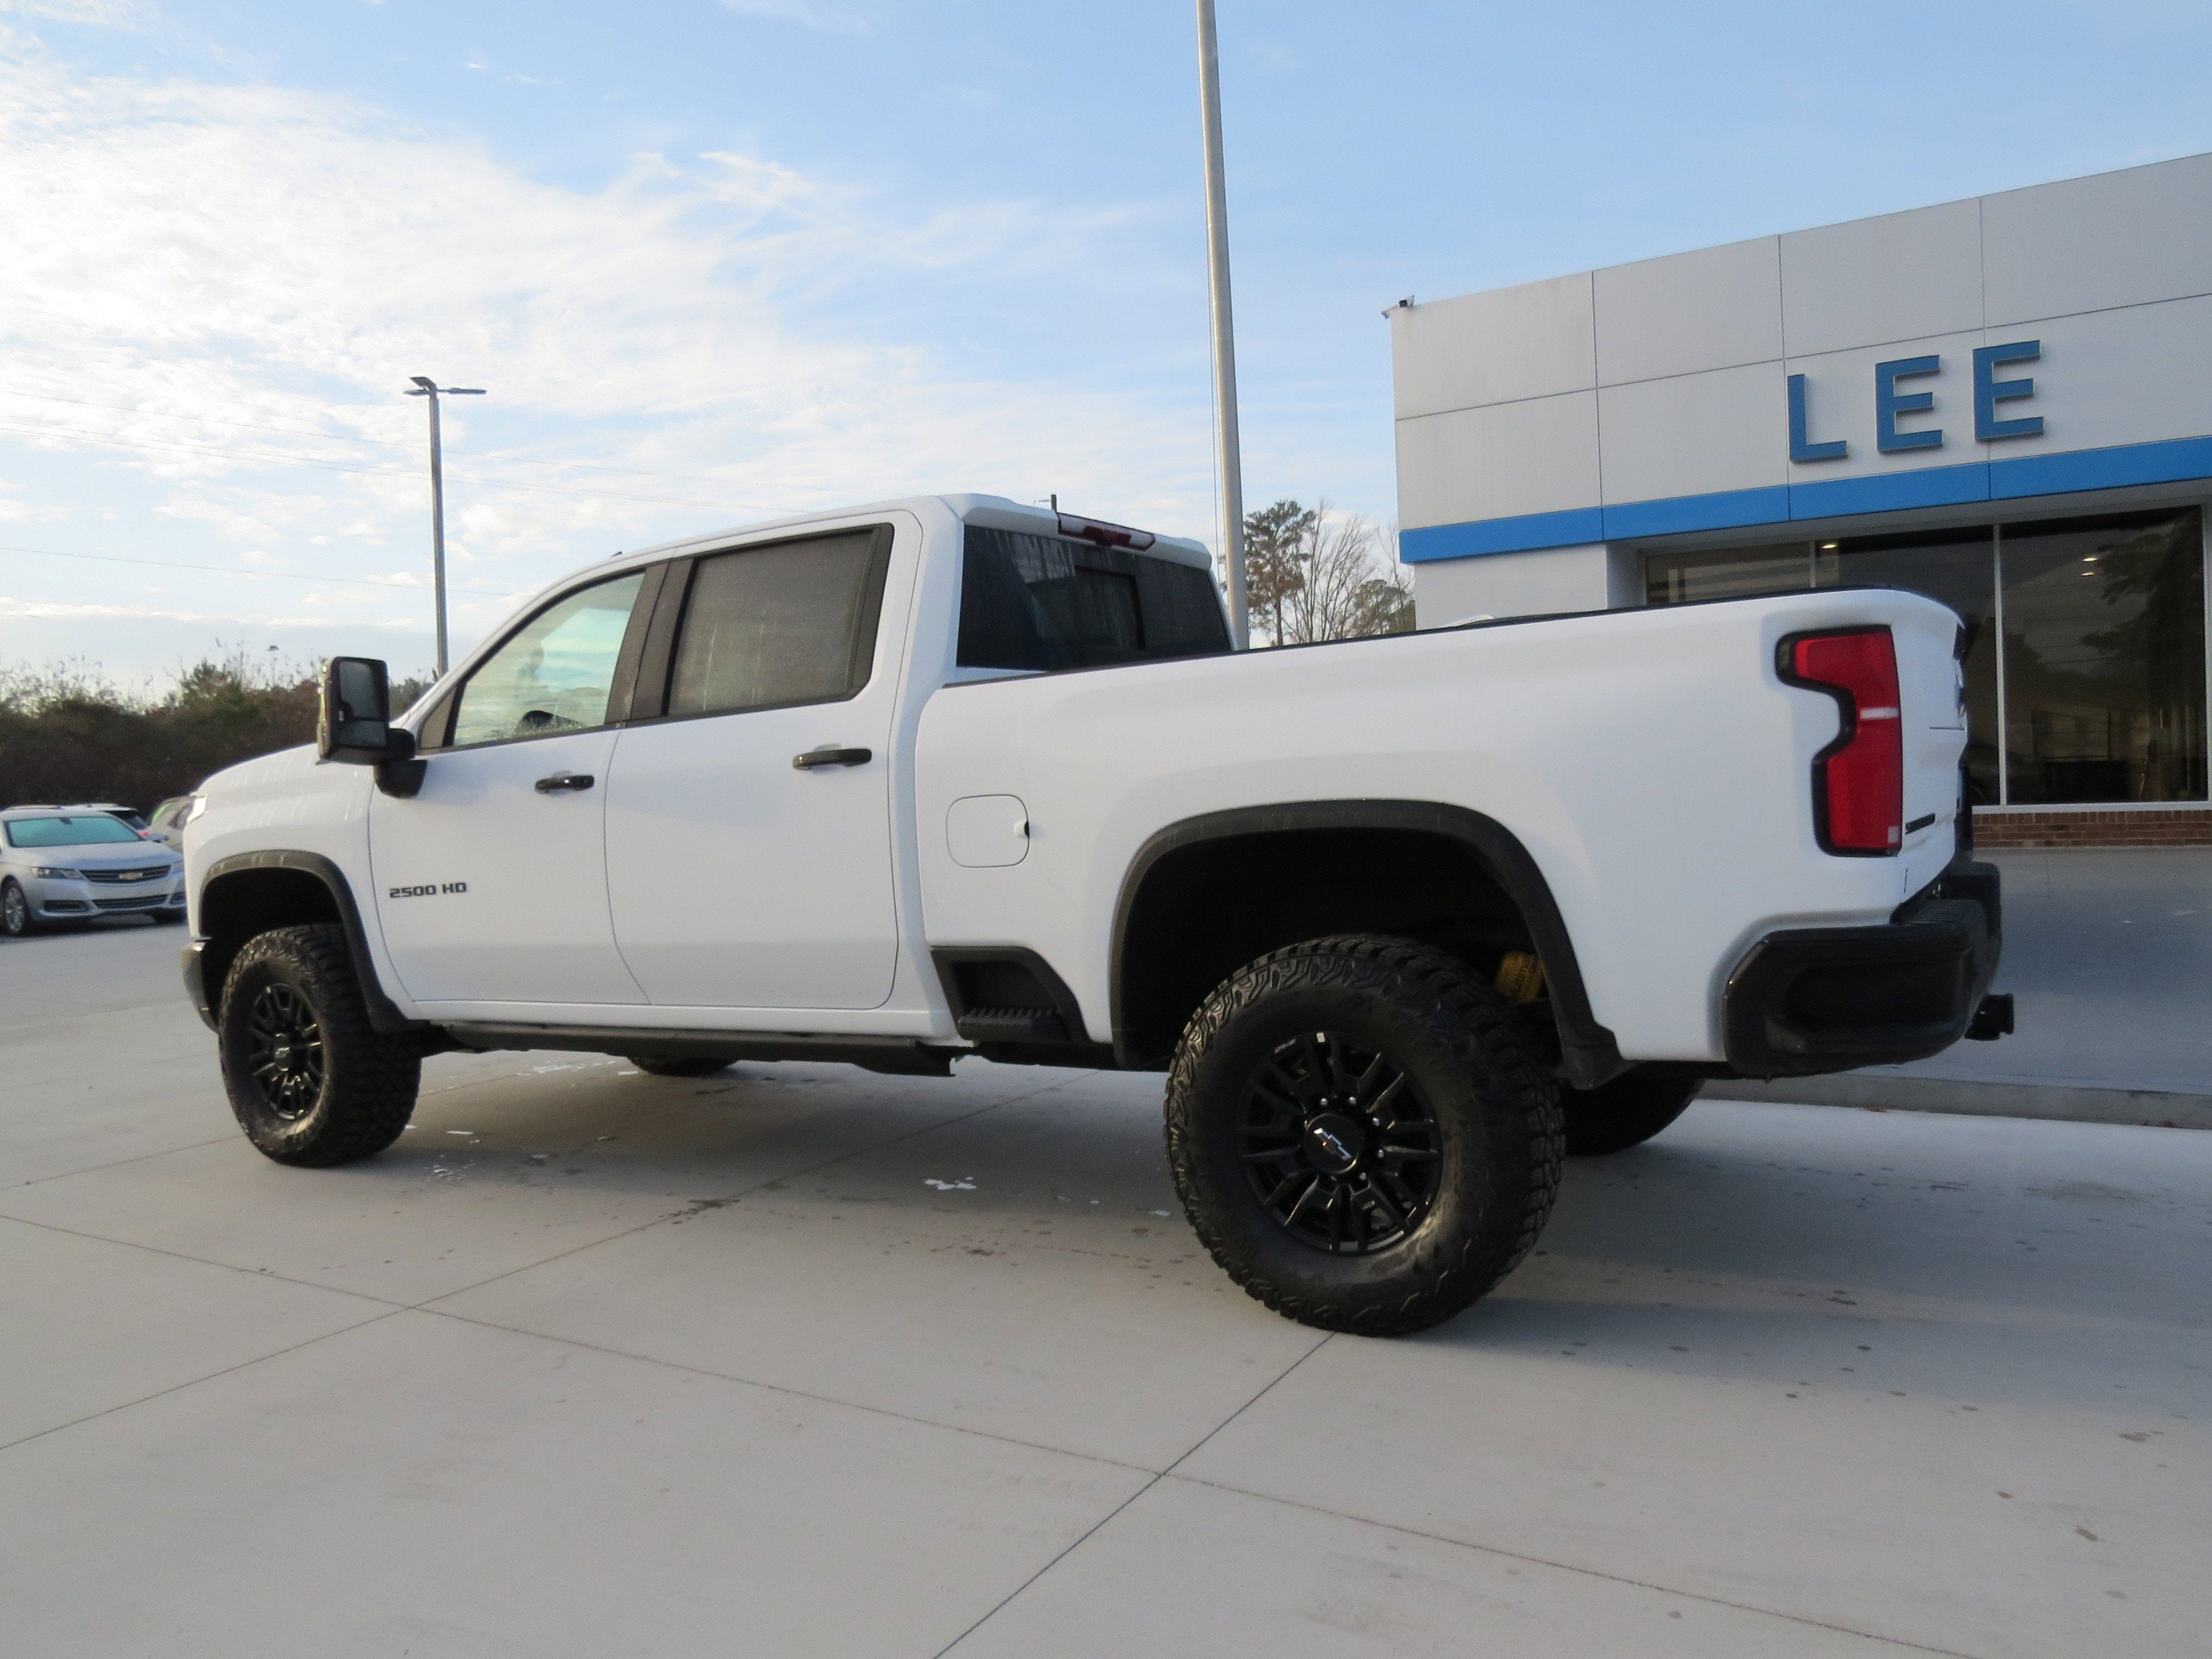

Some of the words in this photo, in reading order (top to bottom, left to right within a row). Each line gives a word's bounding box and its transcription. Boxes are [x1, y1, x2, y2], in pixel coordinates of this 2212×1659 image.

[1787, 340, 2044, 462] LEE
[389, 885, 436, 898] 2500
[442, 882, 467, 893] HD
